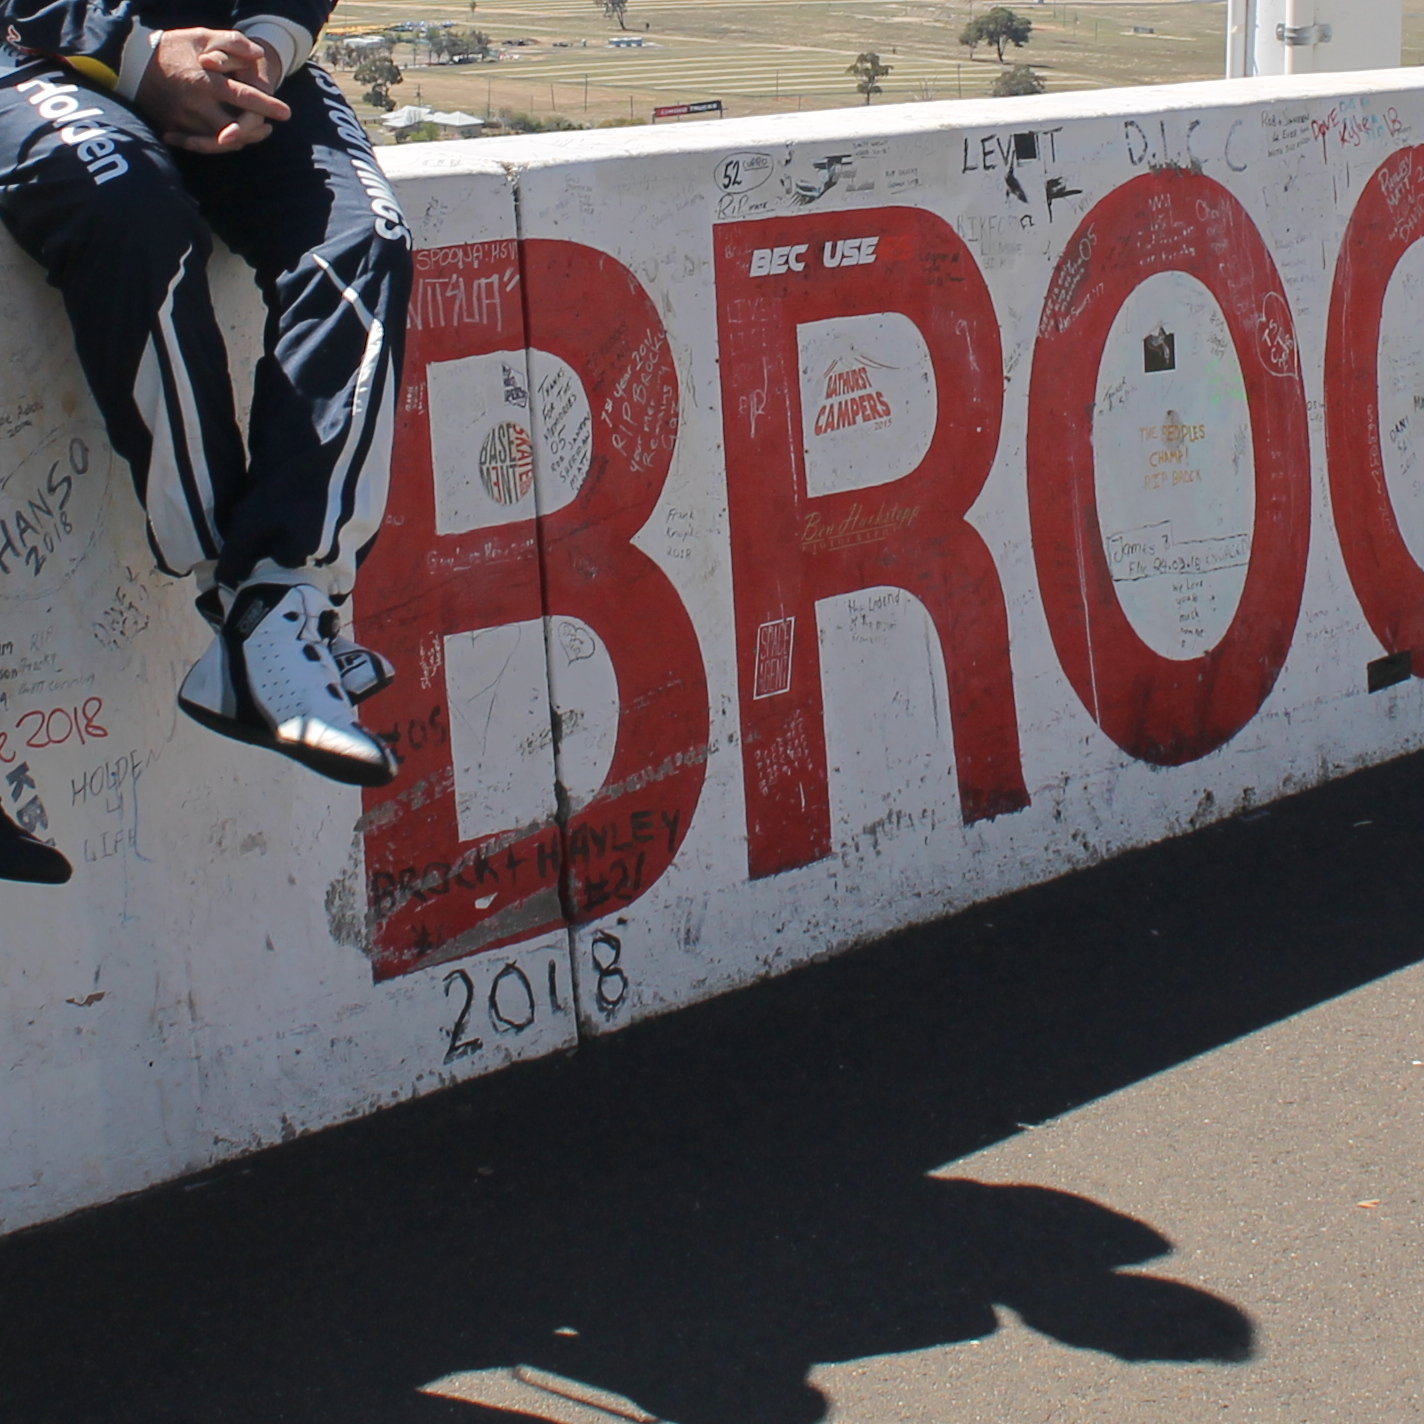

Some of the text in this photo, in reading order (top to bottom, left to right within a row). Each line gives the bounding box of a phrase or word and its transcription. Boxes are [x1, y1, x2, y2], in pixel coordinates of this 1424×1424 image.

[16, 71, 130, 186] Holden
[961, 127, 1064, 174] LEVTT
[825, 366, 873, 400] BATHURST
[814, 390, 891, 436] CAMPERS
[15, 696, 109, 749] 2018
[442, 928, 630, 1065] 2018
